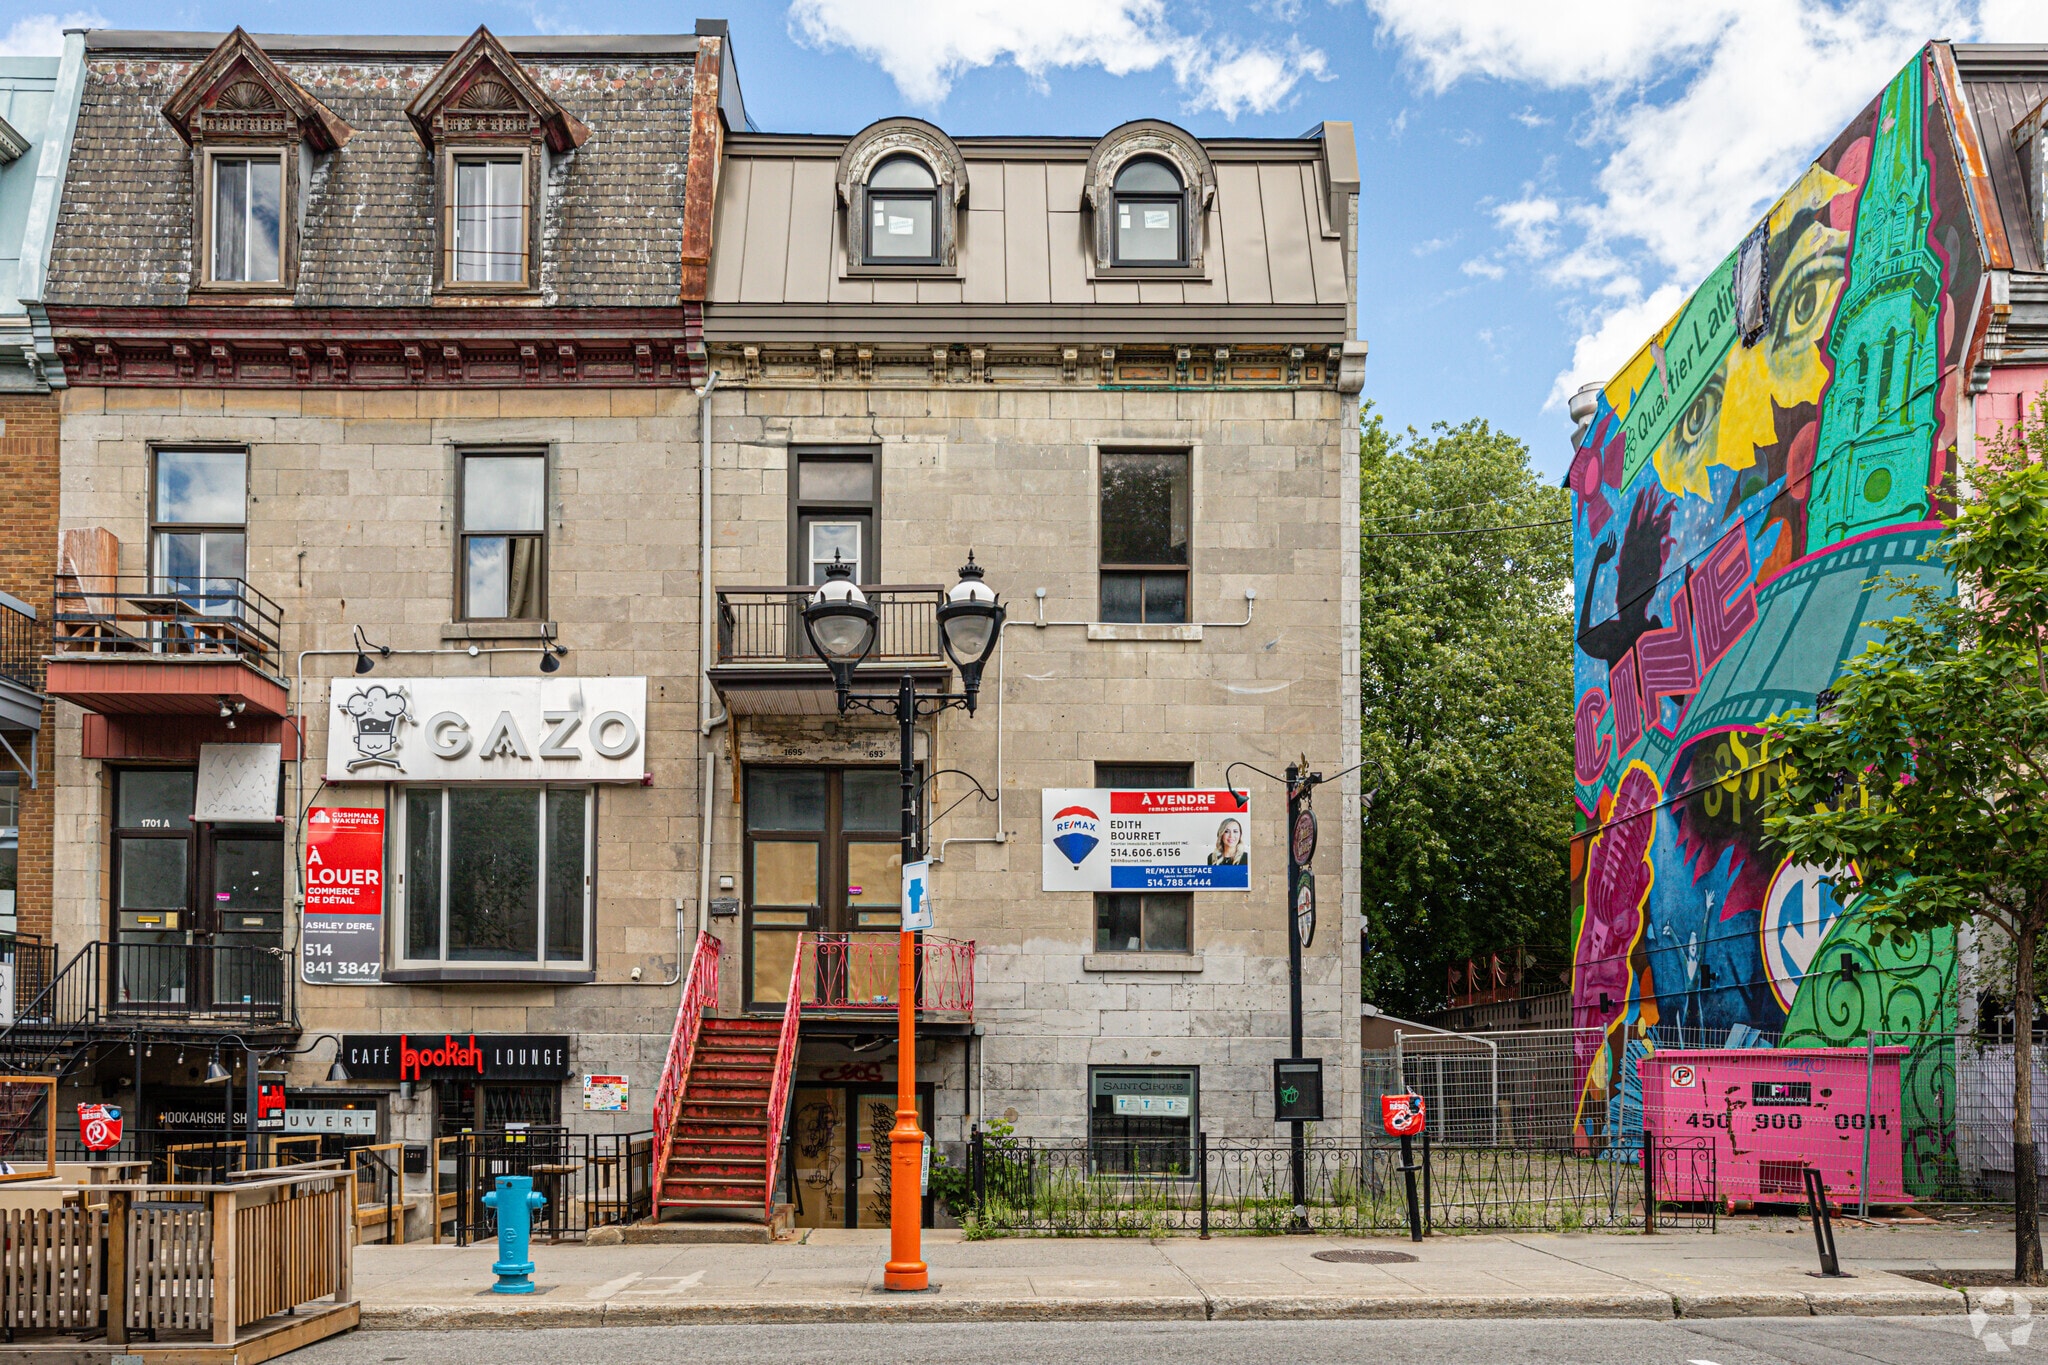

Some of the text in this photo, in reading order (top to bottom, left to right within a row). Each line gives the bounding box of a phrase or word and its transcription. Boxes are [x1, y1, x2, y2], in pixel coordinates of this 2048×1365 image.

[425, 710, 639, 760] GAZO
[1142, 793, 1216, 805] À VENDRE
[1148, 805, 1209, 813] remax-quebec.com
[141, 819, 170, 828] 1701 A
[1056, 820, 1096, 832] RE/MAX
[1110, 820, 1142, 829] EDITH
[1110, 831, 1161, 841] BOURRET
[307, 845, 323, 865] À
[1110, 848, 1181, 857] 514.606.6156
[1145, 867, 1175, 875] RE/MAX
[307, 868, 379, 886] LOUER
[1147, 878, 1212, 887] 514.788.4444
[308, 887, 360, 896] COMMERCE
[307, 895, 355, 904] DE DÉTAIL
[305, 921, 375, 932] ASHLEY DERE,
[305, 944, 333, 956] 514
[305, 961, 380, 975] 841 3847
[351, 1034, 562, 1081] CAFÉ hookah LOUNGE
[1686, 1112, 1731, 1129] 450
[1755, 1113, 1802, 1130] 900
